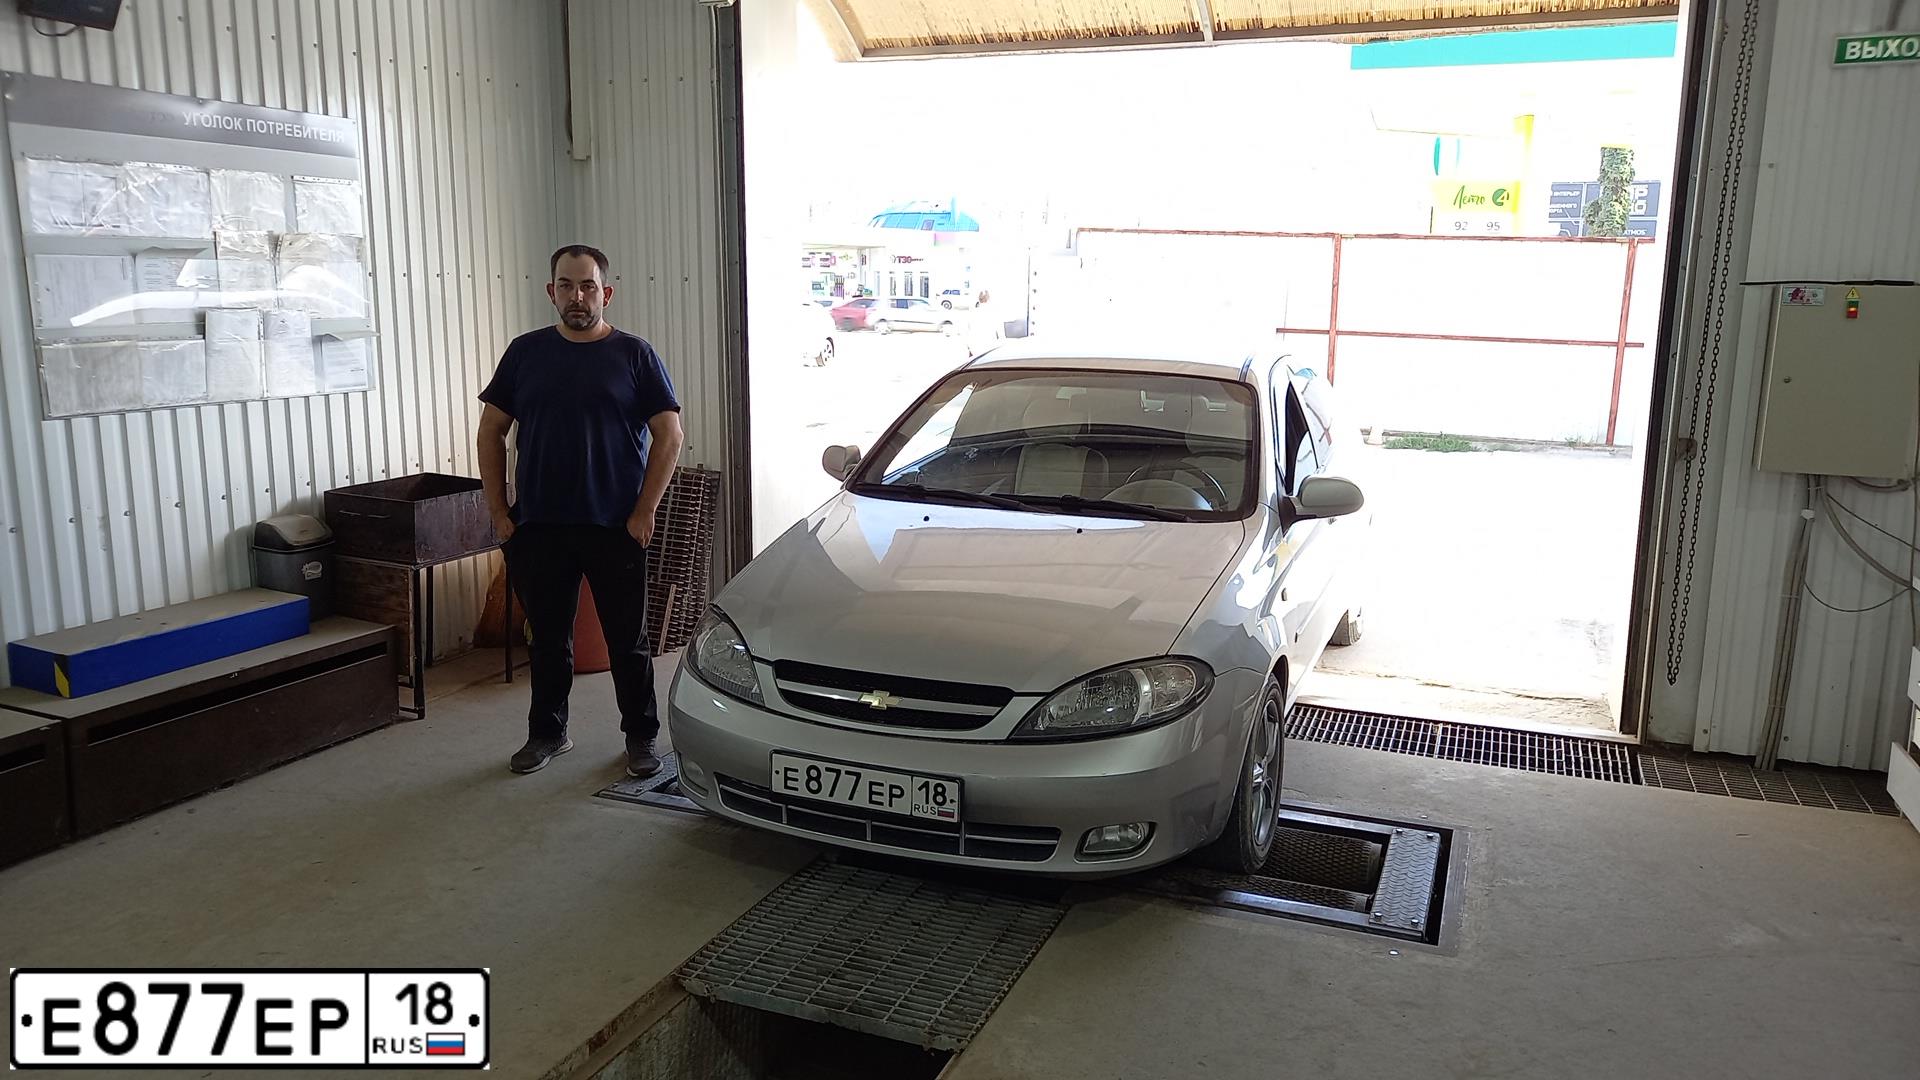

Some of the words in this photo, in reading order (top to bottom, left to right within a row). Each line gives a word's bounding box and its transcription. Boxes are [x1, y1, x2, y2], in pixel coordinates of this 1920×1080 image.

[1845, 37, 1920, 60] ВЫХО
[183, 111, 243, 132] УГОЛОК
[246, 119, 345, 144] ПОТРЕБИТЕЛЯ
[1486, 221, 1501, 231] 95
[783, 764, 905, 808] Е877ЕР
[917, 780, 948, 807] 18
[913, 803, 937, 816] RUS
